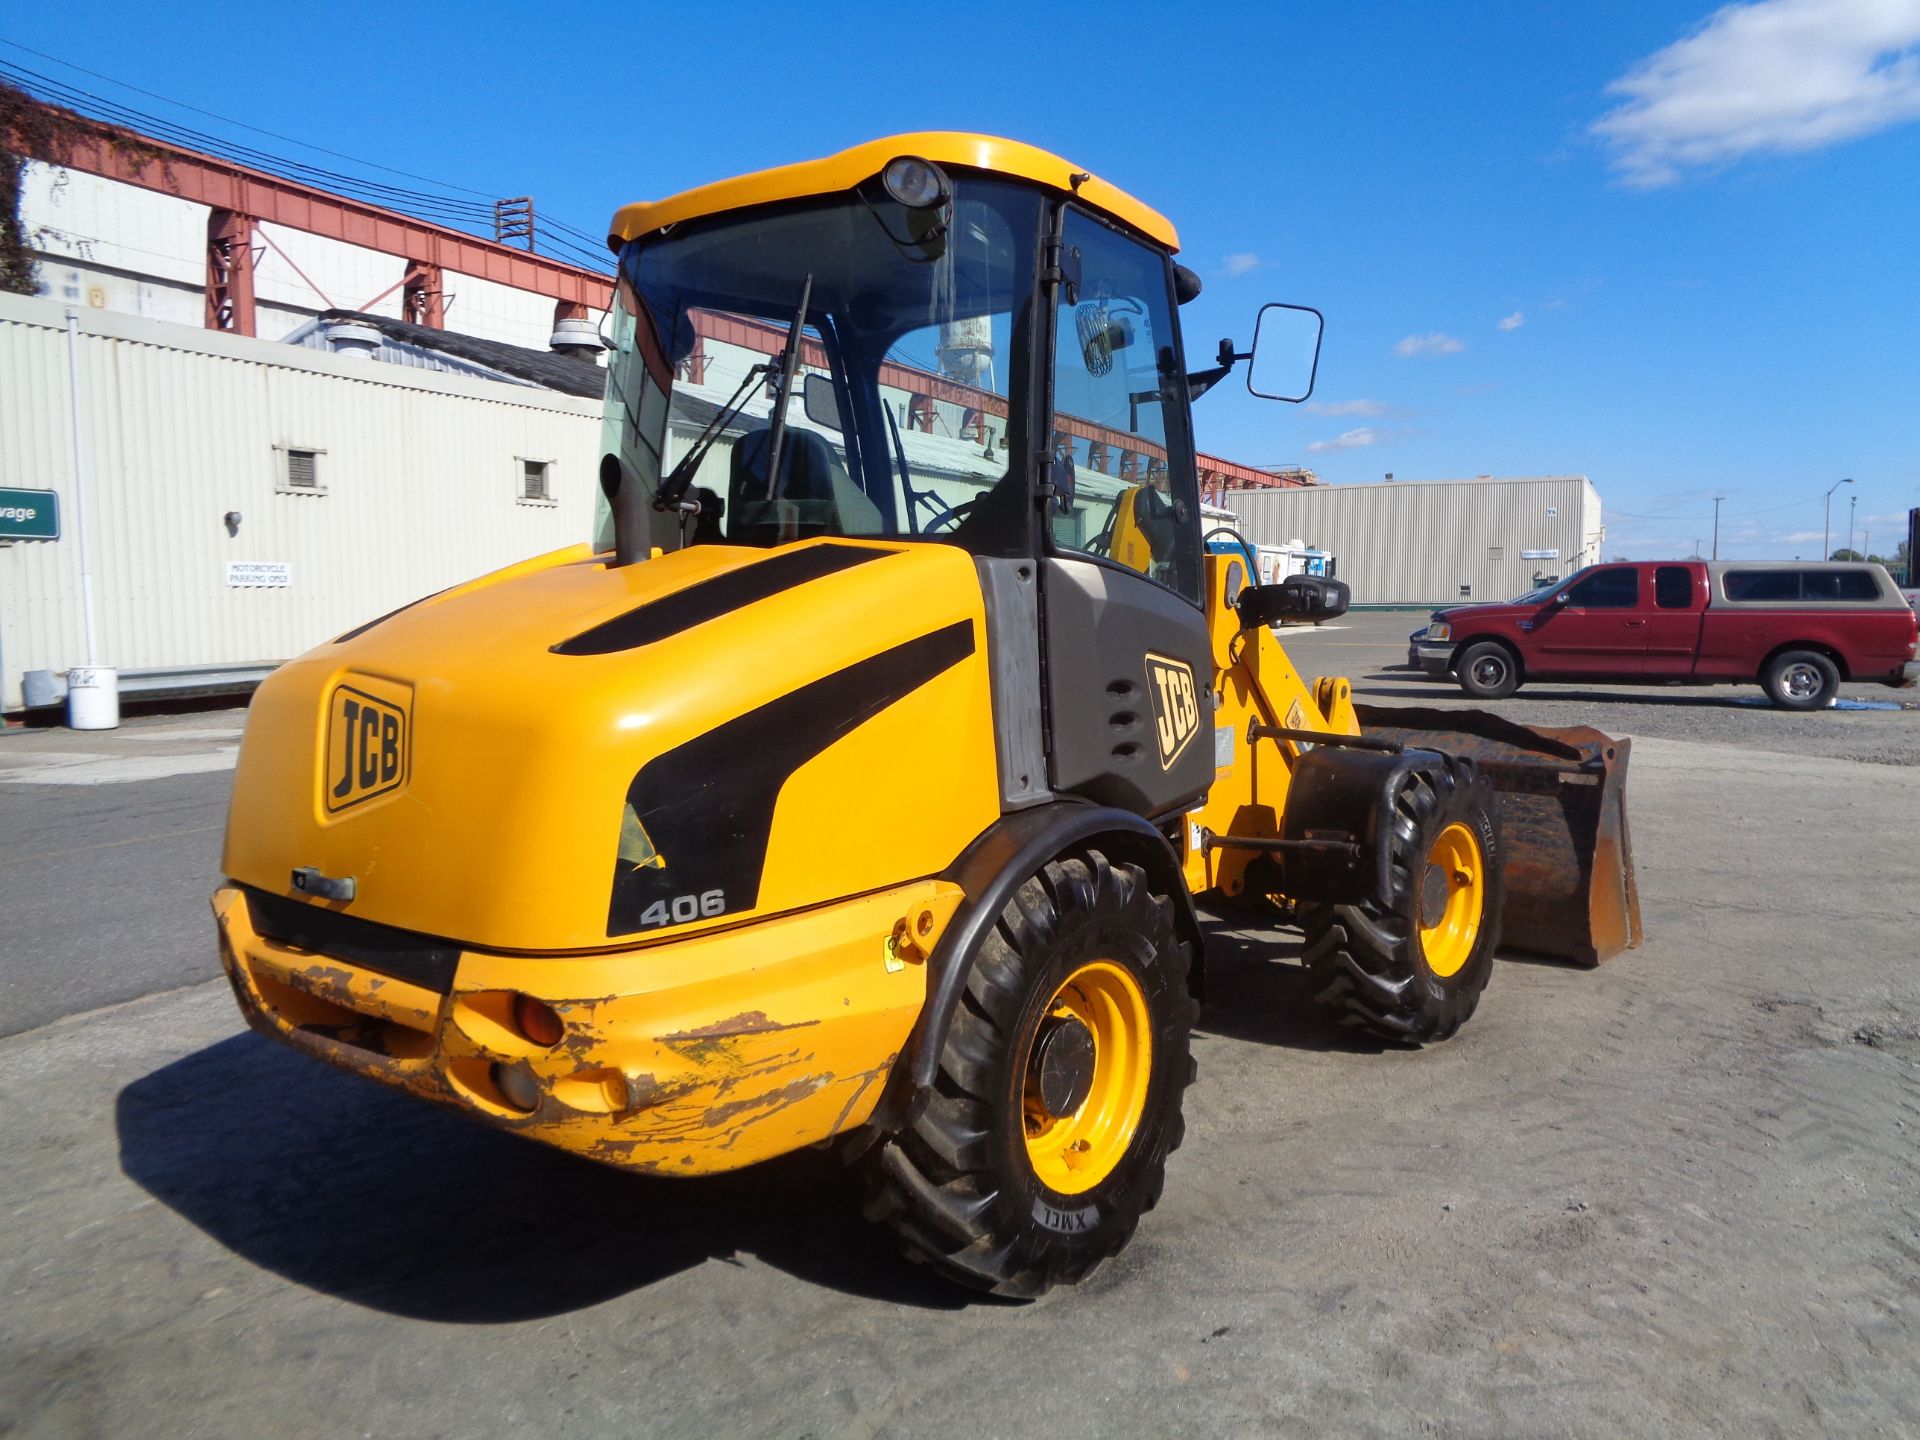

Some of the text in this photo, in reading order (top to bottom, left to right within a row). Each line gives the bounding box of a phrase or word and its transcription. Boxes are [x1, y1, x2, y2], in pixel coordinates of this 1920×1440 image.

[229, 574, 266, 583] PARKING
[1154, 666, 1196, 756] JCB
[333, 698, 399, 798] JCB
[640, 889, 726, 926] 406
[1043, 1206, 1087, 1230] XMCL
